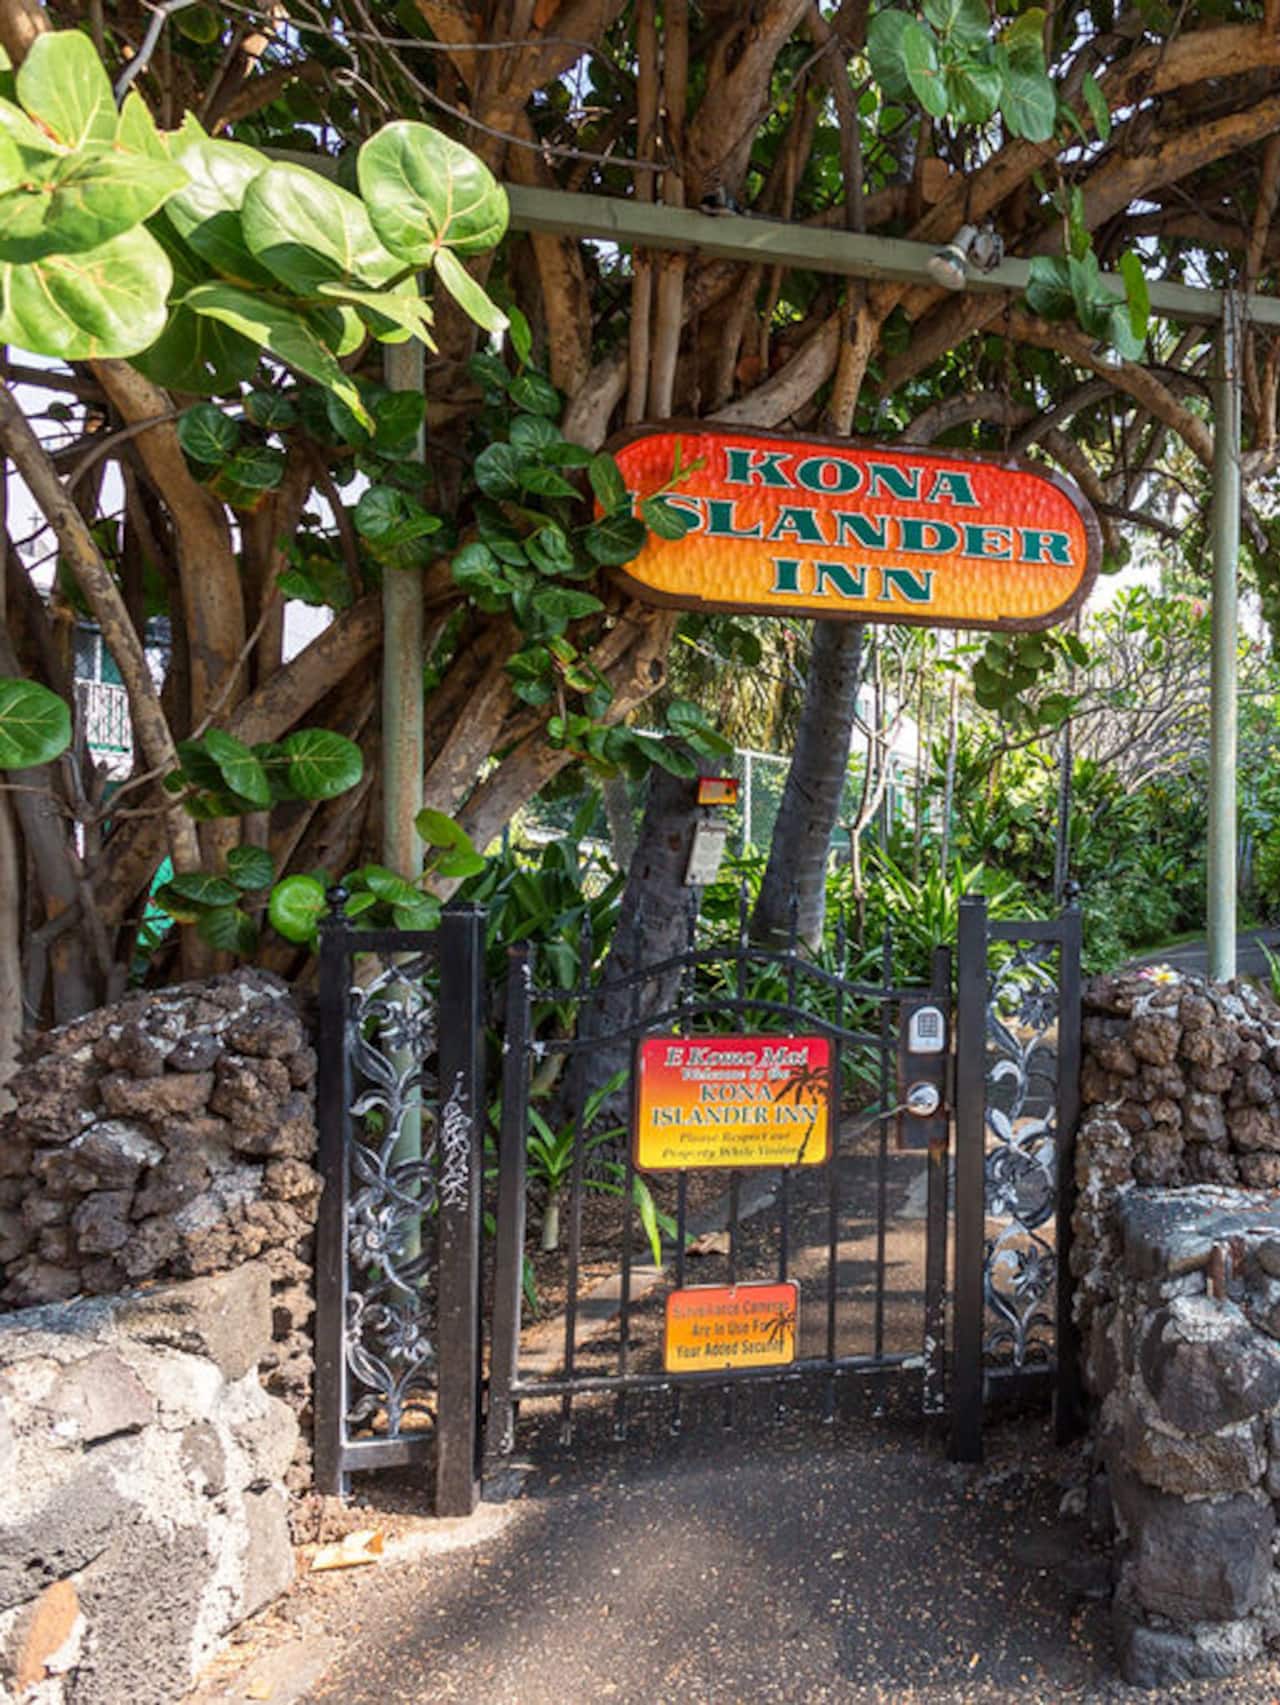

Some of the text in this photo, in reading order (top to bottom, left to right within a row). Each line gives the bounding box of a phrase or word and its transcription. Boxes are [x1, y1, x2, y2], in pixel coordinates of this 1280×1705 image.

[723, 447, 980, 507] KONA
[771, 557, 935, 604] INN
[664, 1046, 810, 1068] E Komo Mai
[681, 1066, 791, 1081] Welcome to the
[701, 1083, 775, 1103] KONA
[652, 1103, 819, 1127] ISLANDER INN
[680, 1131, 718, 1144] Please
[692, 1323, 711, 1337] Are
[727, 1320, 749, 1335] Use
[676, 1345, 702, 1359] Your
[704, 1342, 739, 1358] Added
